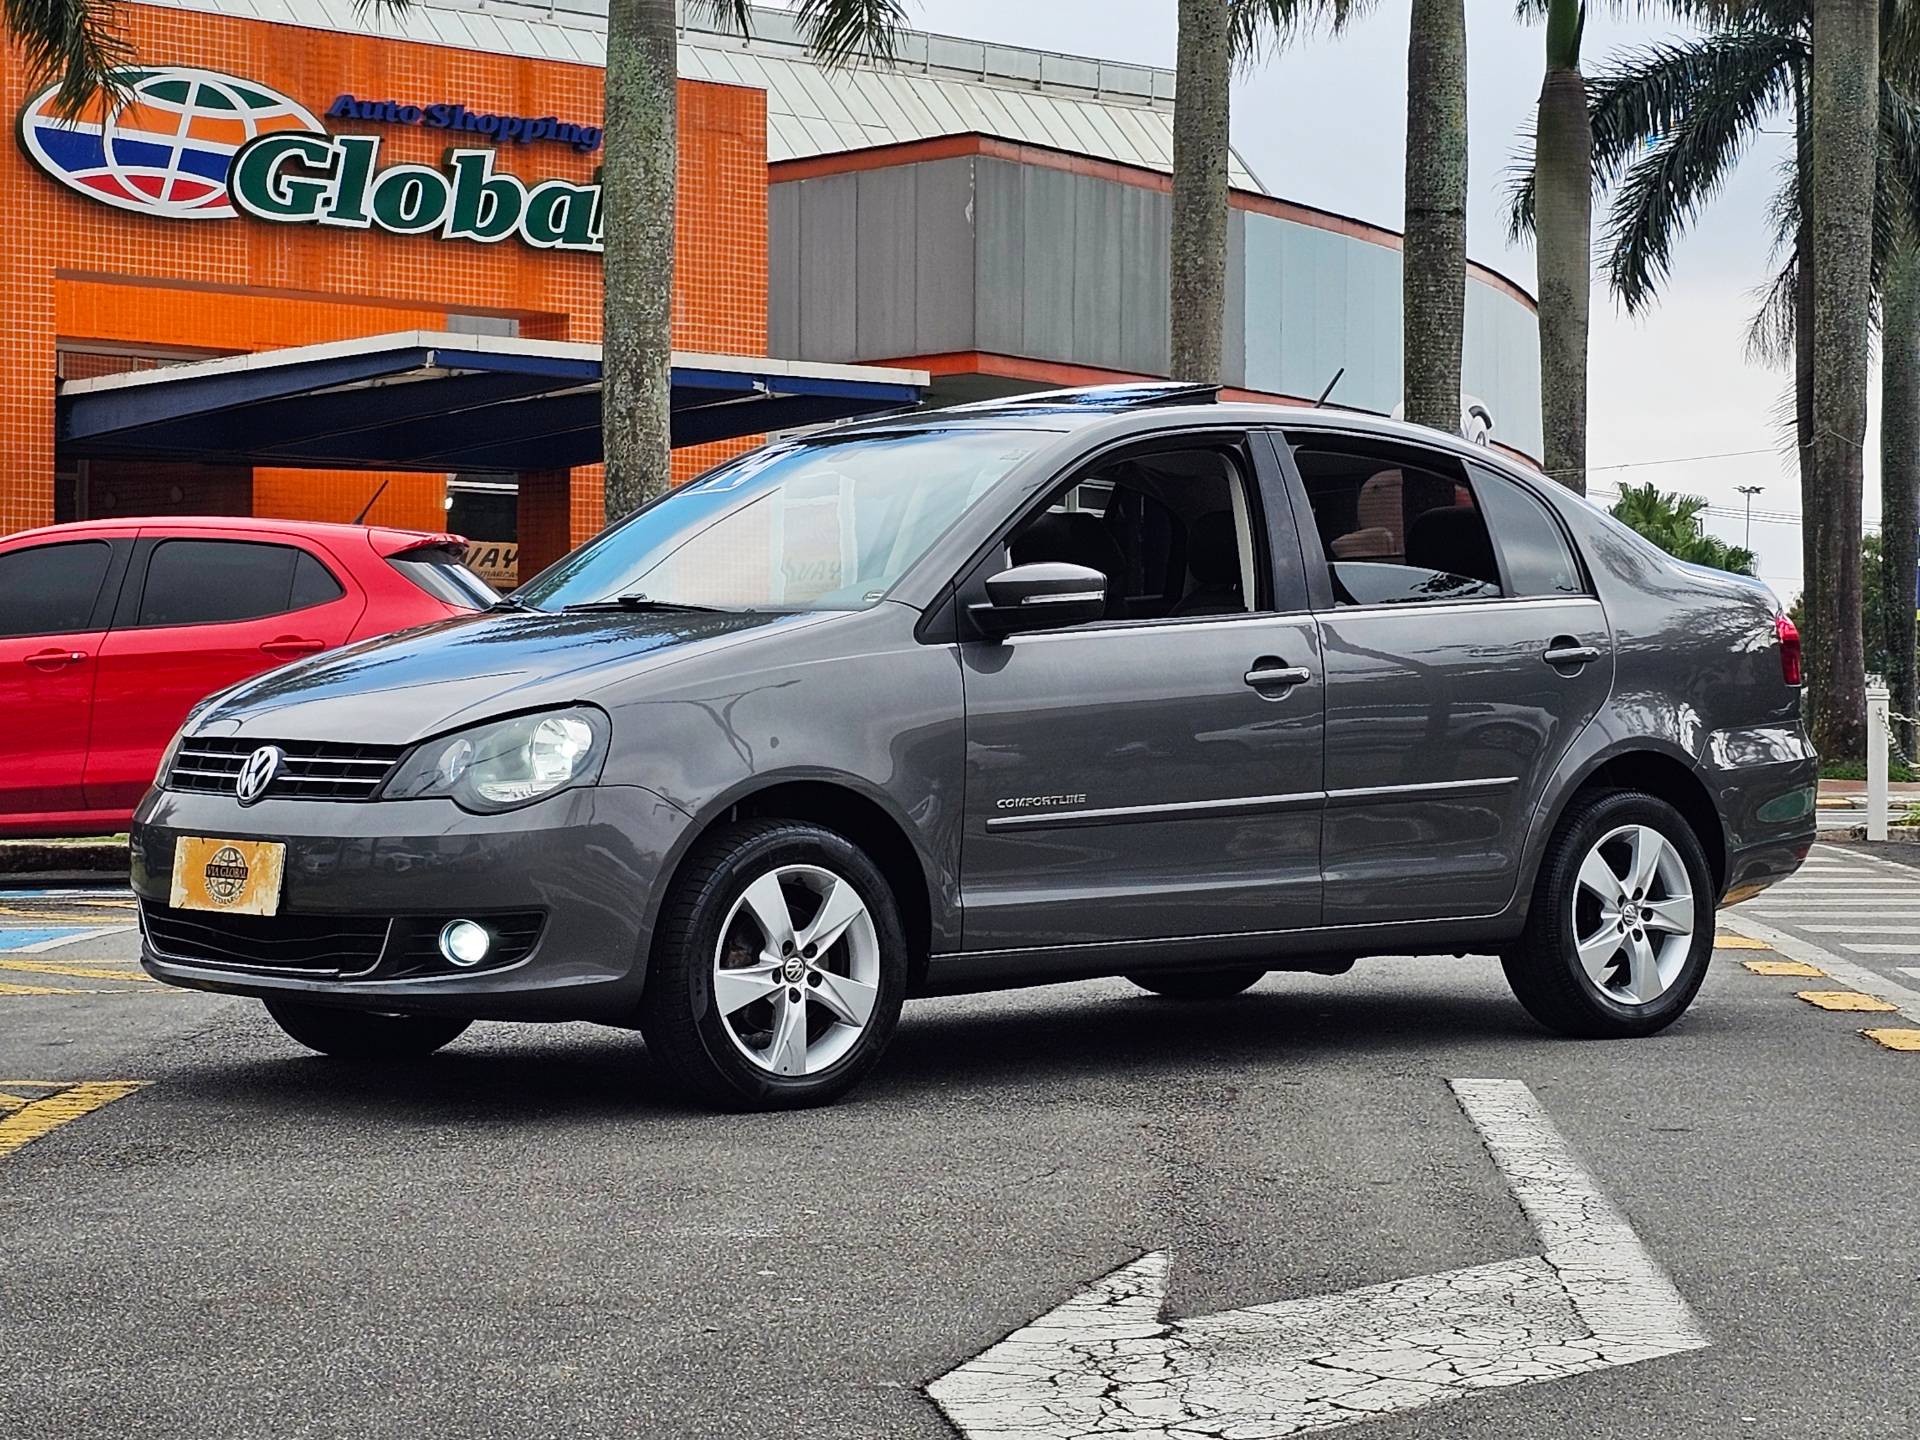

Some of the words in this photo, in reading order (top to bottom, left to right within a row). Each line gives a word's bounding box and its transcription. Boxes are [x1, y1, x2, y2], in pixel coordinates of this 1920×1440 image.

[325, 94, 422, 124] Auto
[424, 104, 603, 151] Shopping
[232, 134, 604, 252] Globa
[996, 793, 1087, 808] COMFORTLINE
